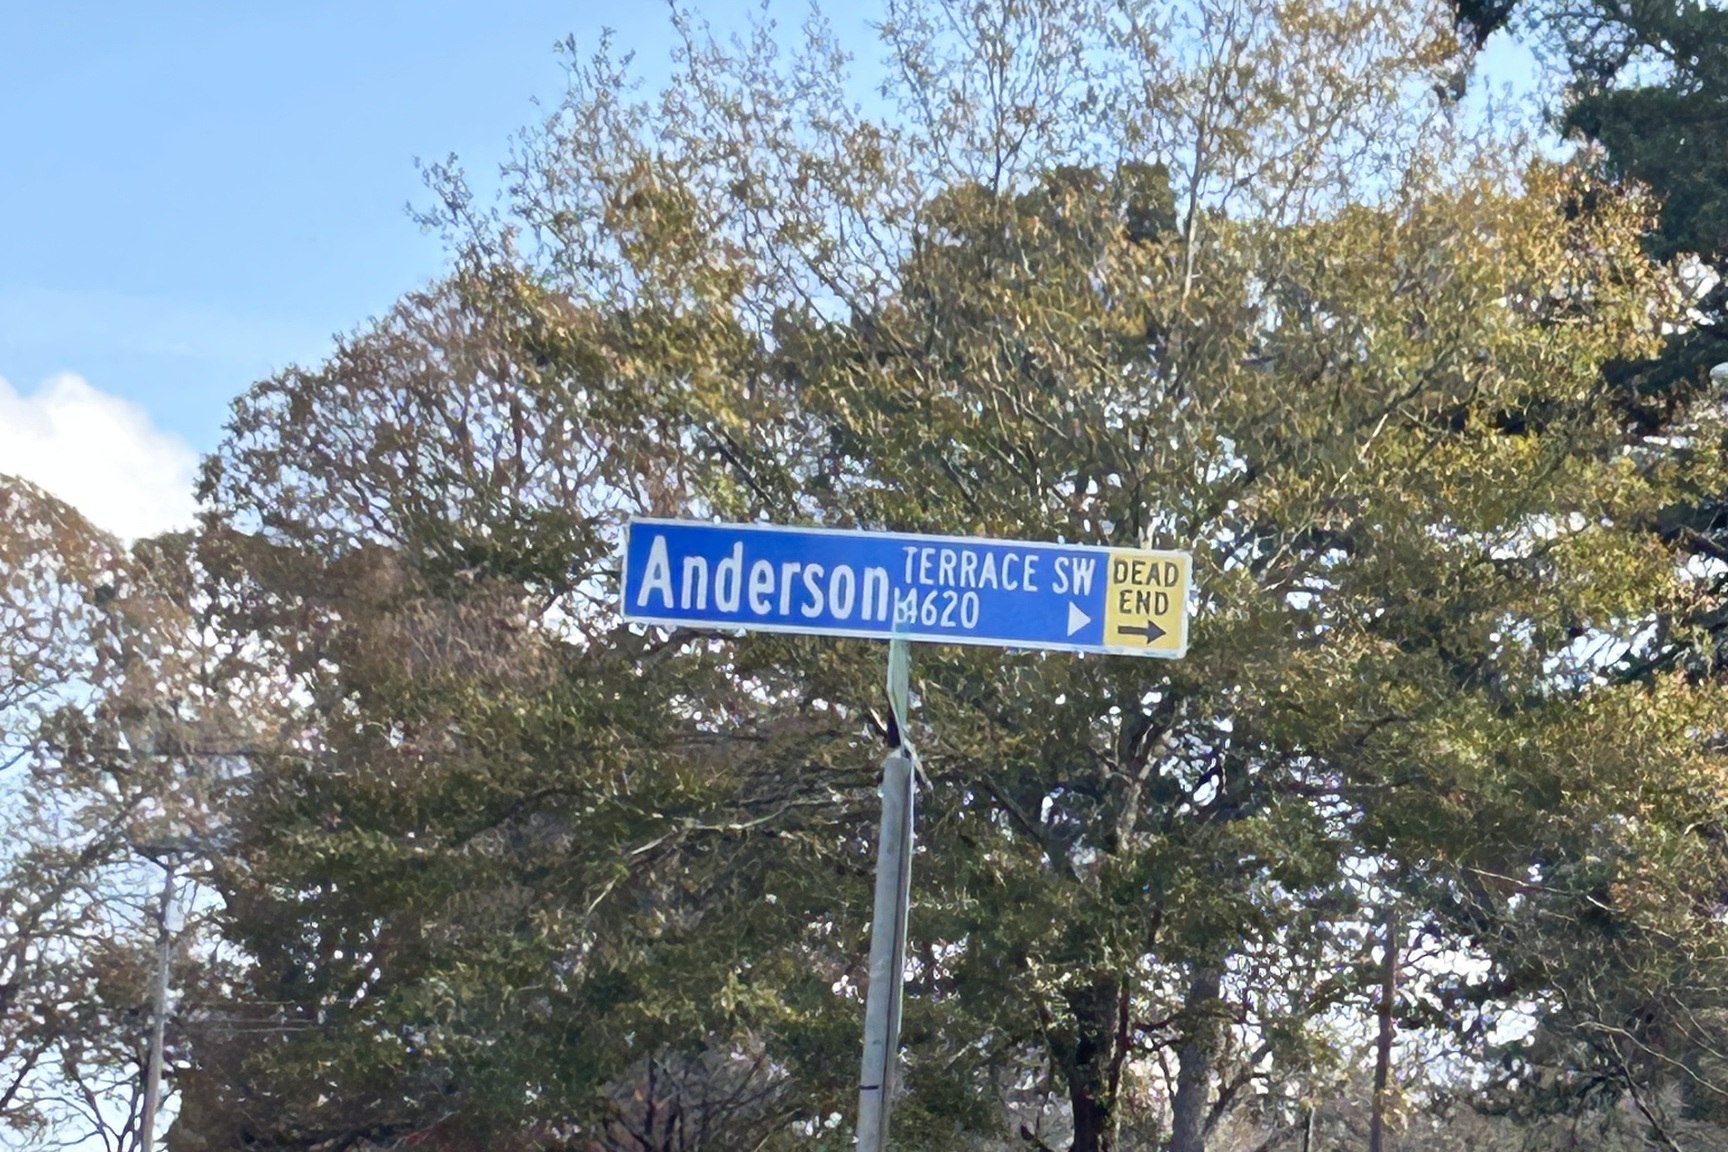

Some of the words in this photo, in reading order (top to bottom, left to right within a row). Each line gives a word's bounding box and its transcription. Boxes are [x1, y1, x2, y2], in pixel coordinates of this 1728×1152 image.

[637, 534, 888, 622] Anderson
[902, 546, 1040, 592] TERRACE
[1052, 556, 1096, 596] SW
[1113, 558, 1179, 588] DEAD
[1119, 589, 1170, 616] END
